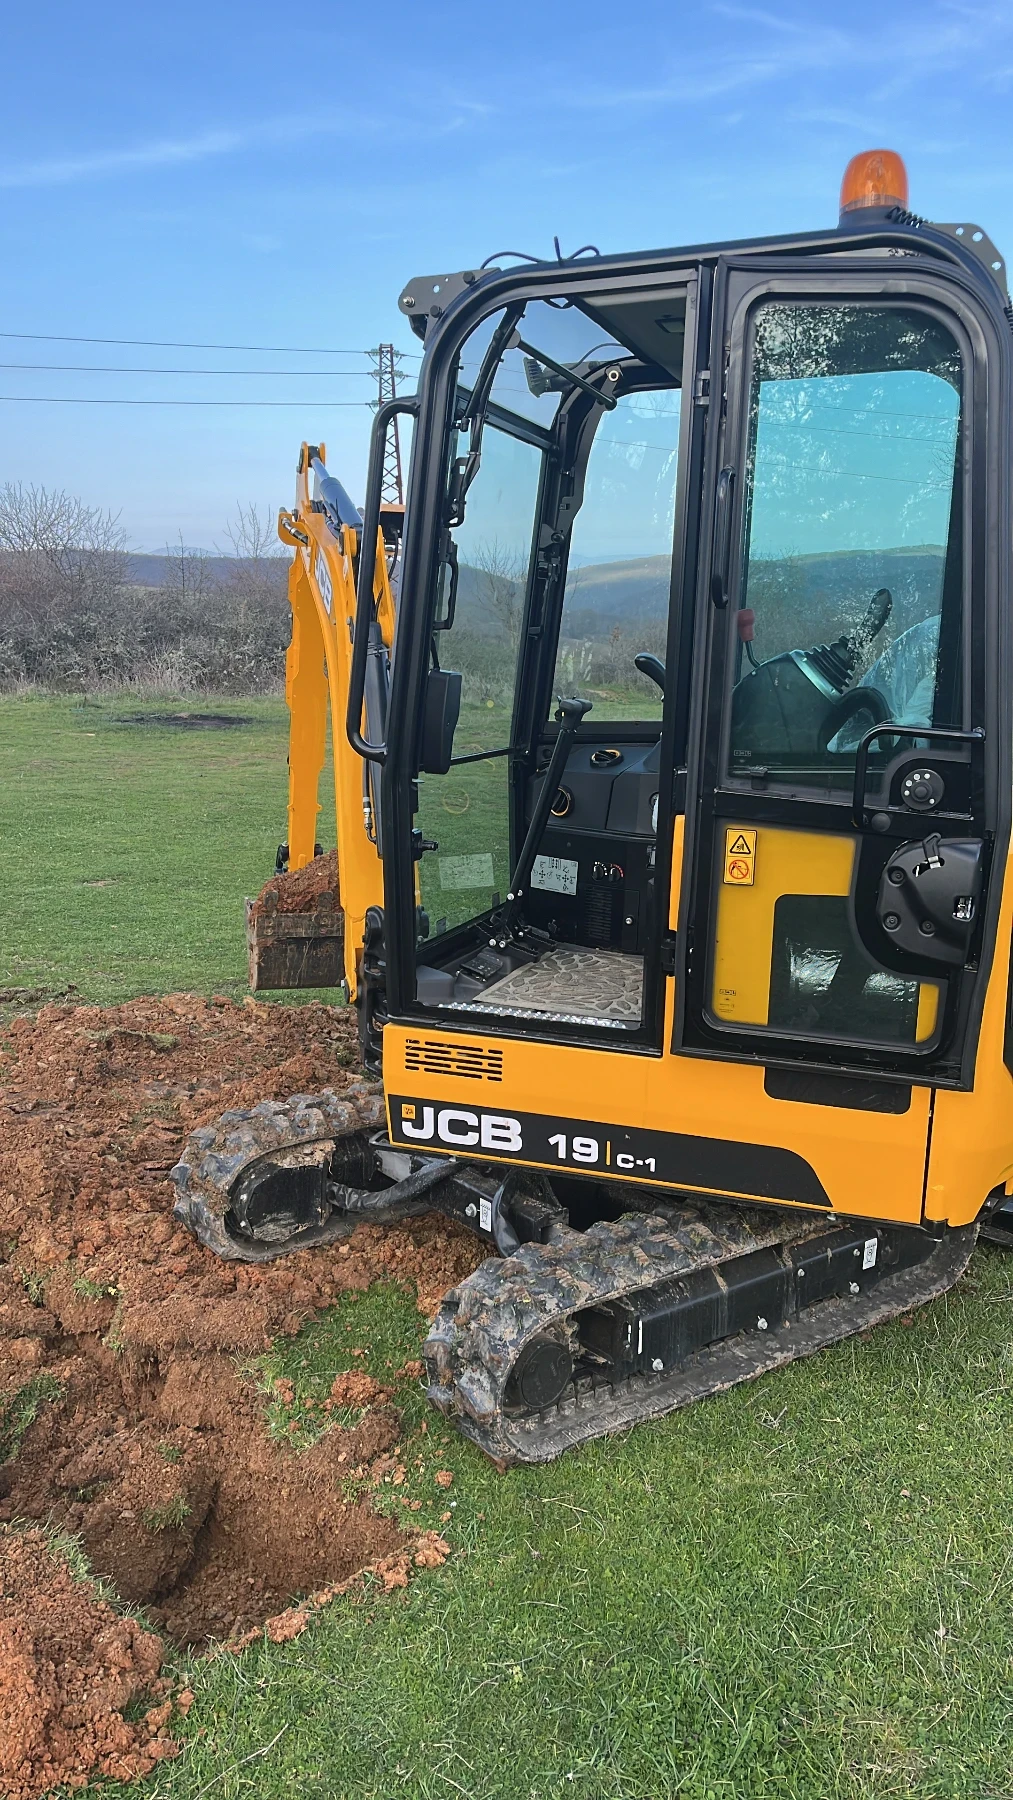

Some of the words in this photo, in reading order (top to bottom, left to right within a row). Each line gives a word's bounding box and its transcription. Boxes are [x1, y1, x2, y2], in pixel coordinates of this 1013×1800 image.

[401, 1106, 523, 1152] JCB
[547, 1133, 599, 1164] 19
[616, 1152, 656, 1173] C-1
